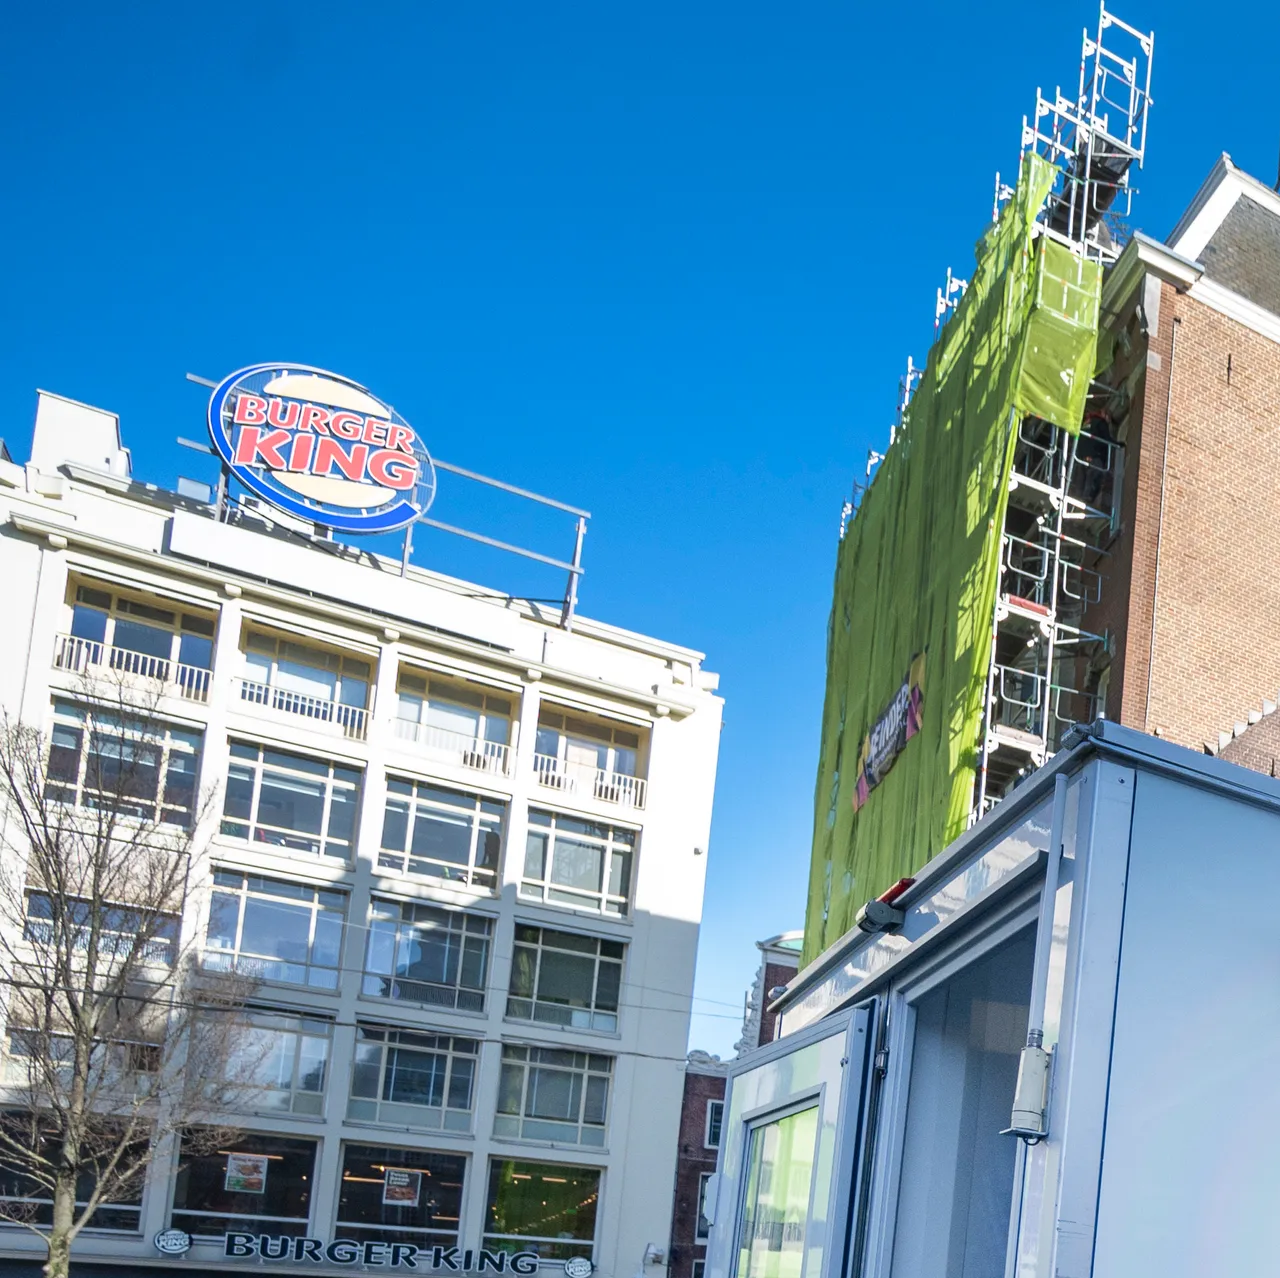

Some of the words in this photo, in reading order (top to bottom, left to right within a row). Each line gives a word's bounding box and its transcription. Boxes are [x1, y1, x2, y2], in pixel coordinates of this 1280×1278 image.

[233, 393, 416, 454] BURGER
[233, 426, 420, 491] KING
[158, 1237, 190, 1248] KING
[224, 1231, 418, 1267] BURGER
[432, 1245, 539, 1275] KING
